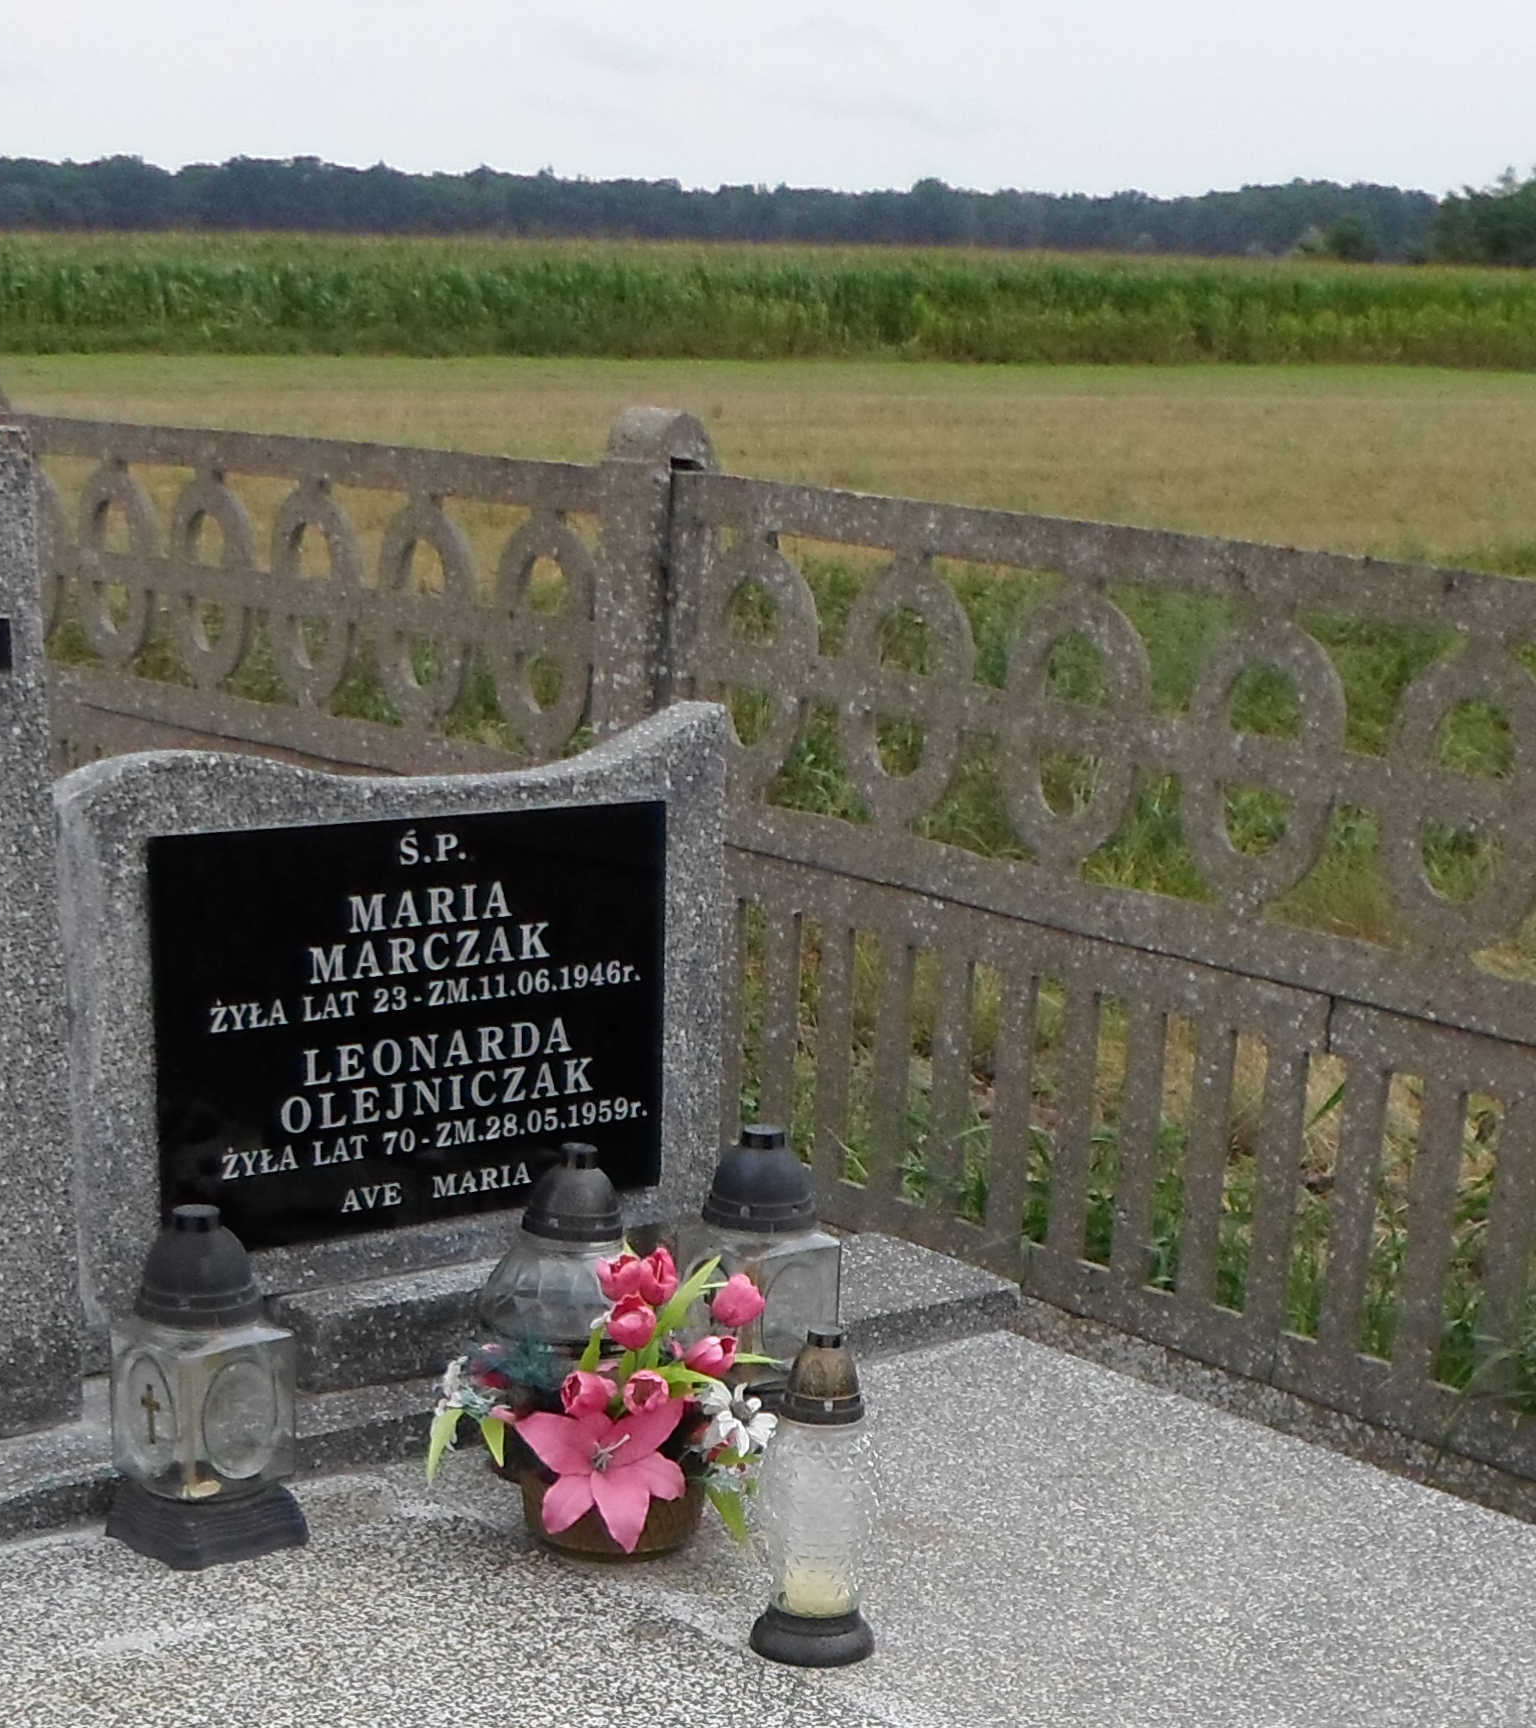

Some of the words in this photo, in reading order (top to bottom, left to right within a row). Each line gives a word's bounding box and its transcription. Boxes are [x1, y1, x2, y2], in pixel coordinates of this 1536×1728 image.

[348, 881, 513, 934] MARIA
[308, 922, 550, 985] MARCZAK
[210, 999, 289, 1034] ŻYŁA
[303, 990, 359, 1022] LAT
[373, 986, 407, 1014] 23
[303, 1017, 572, 1086] LEONARDA
[280, 1057, 593, 1134] OLEJNICZAK
[221, 1144, 299, 1180] ŻYŁA
[312, 1134, 369, 1166] LAT
[382, 1128, 416, 1155] 70
[341, 1182, 402, 1213] AVE
[432, 1162, 532, 1199] MARIA
